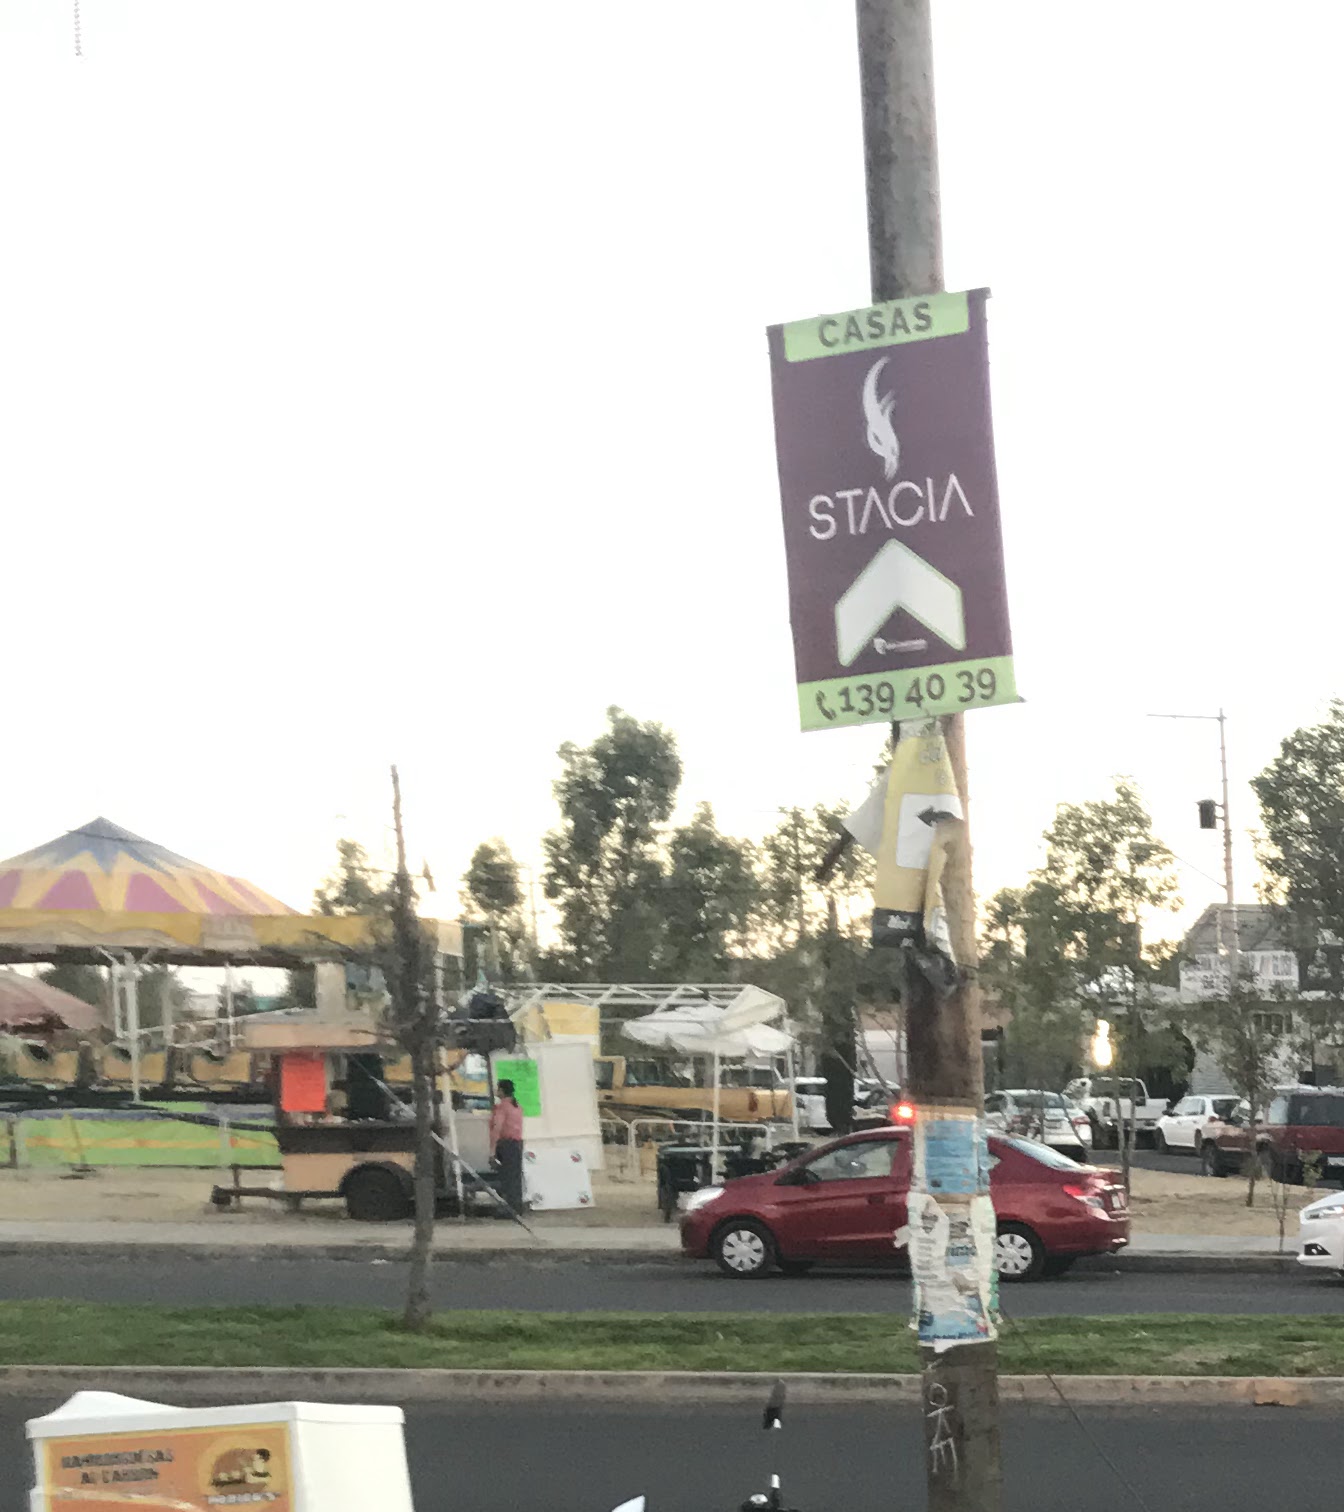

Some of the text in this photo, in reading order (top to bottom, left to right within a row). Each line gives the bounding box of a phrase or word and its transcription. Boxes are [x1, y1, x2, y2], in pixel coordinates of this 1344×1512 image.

[818, 302, 933, 348] CASAS
[809, 473, 974, 541] STACIA
[839, 668, 997, 715] 139 40 39
